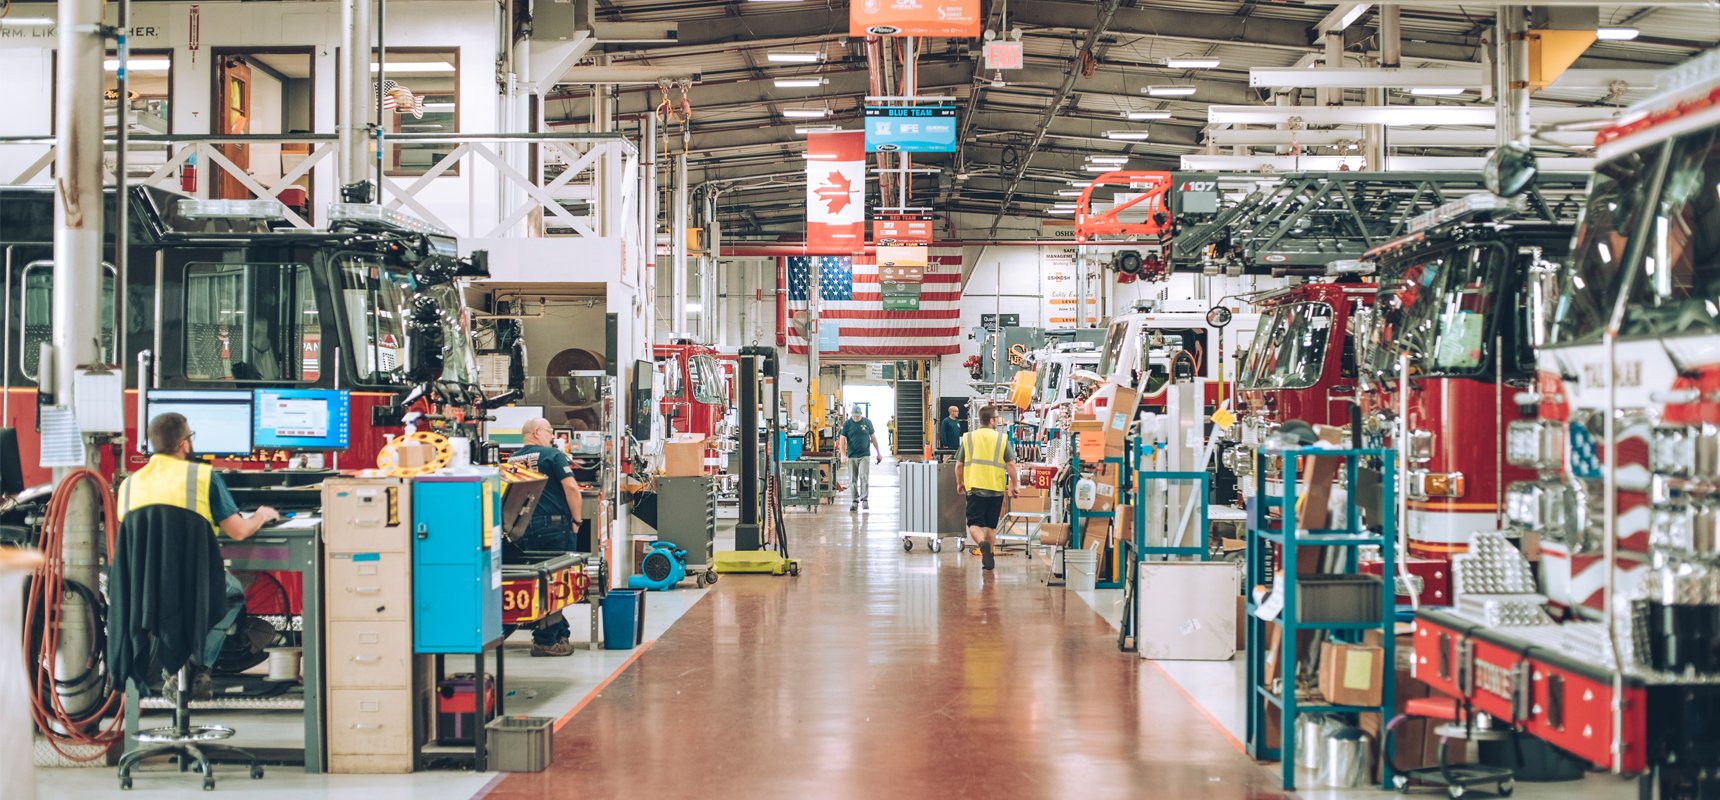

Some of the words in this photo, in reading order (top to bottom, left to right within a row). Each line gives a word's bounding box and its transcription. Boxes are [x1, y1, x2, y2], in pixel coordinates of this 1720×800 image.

[32, 28, 57, 38] LIK
[990, 45, 1019, 67] EXIT
[888, 109, 908, 117] BLUE
[911, 109, 932, 117] TEAM
[1038, 475, 1049, 487] 81
